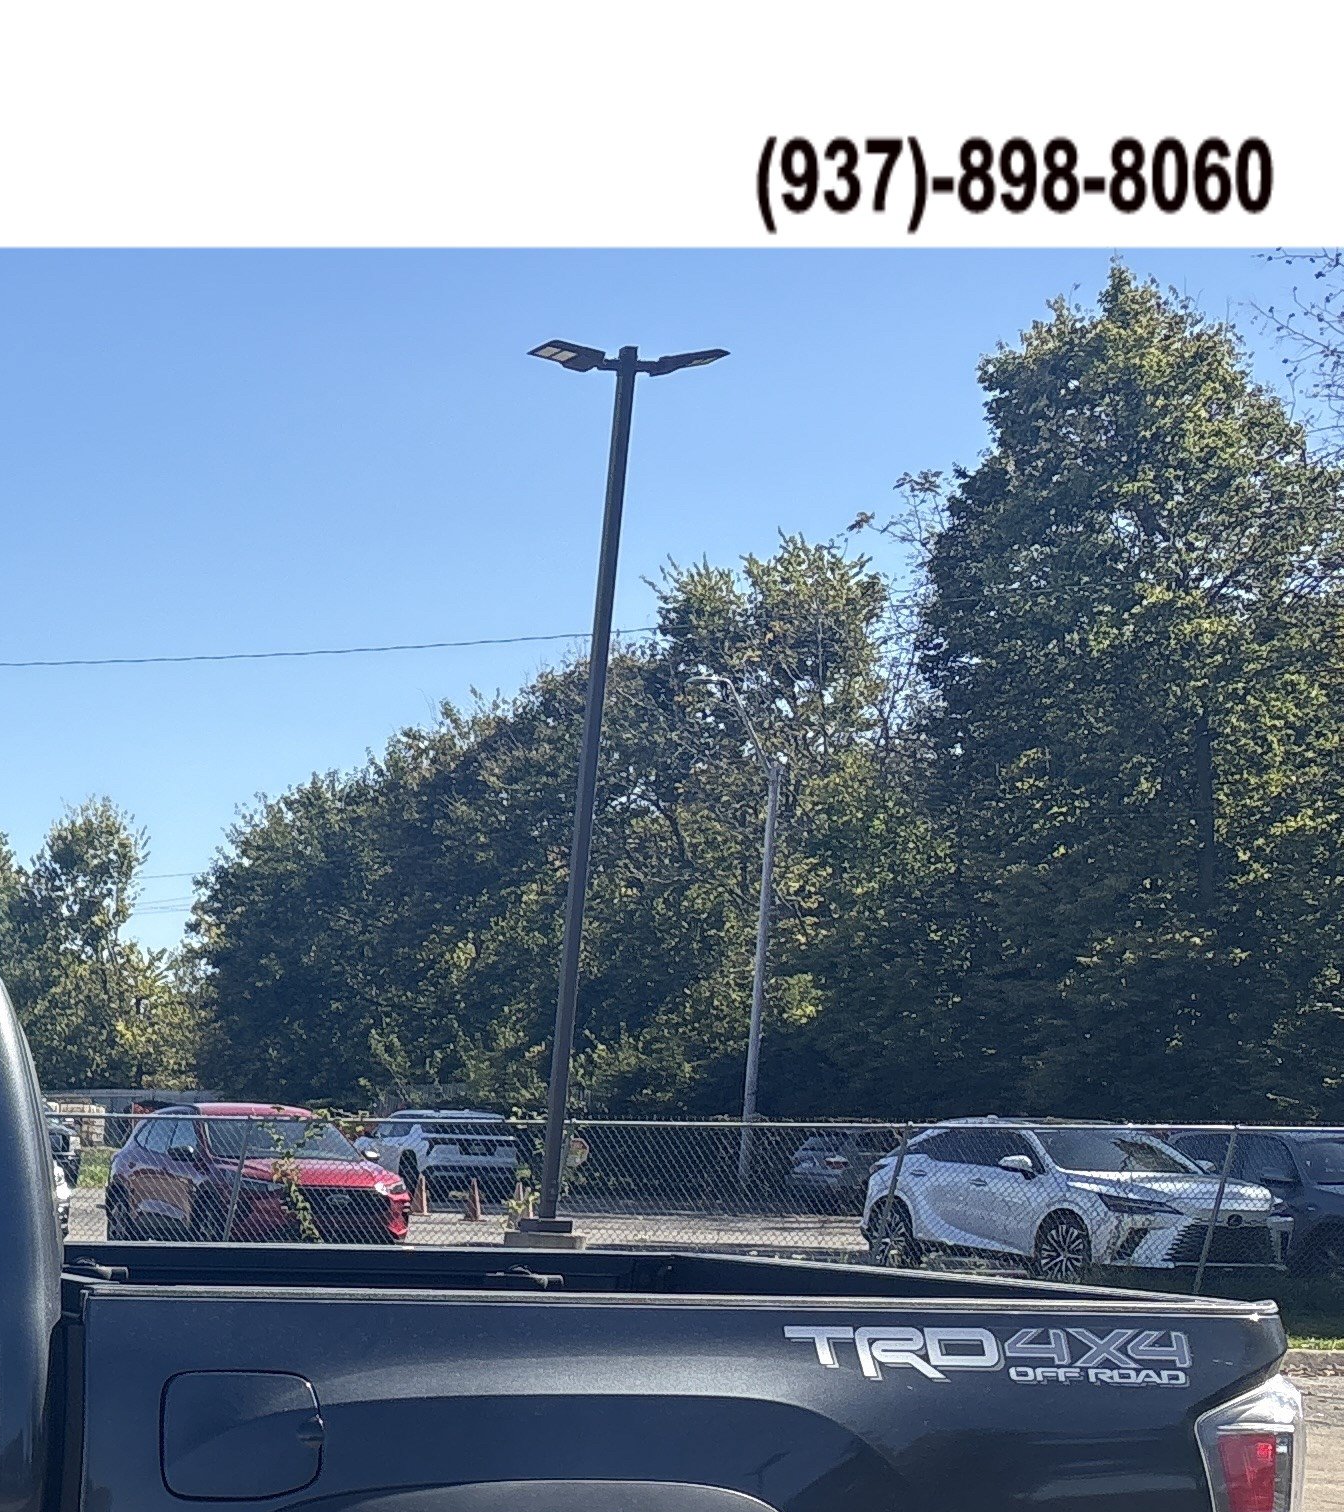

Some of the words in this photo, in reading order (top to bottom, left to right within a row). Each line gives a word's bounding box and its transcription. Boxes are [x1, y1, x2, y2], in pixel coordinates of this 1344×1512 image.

[783, 1326, 1004, 1382] TRD
[1004, 1327, 1192, 1369] 4X4
[1009, 1366, 1080, 1385] OFF
[1088, 1368, 1190, 1388] ROAD
